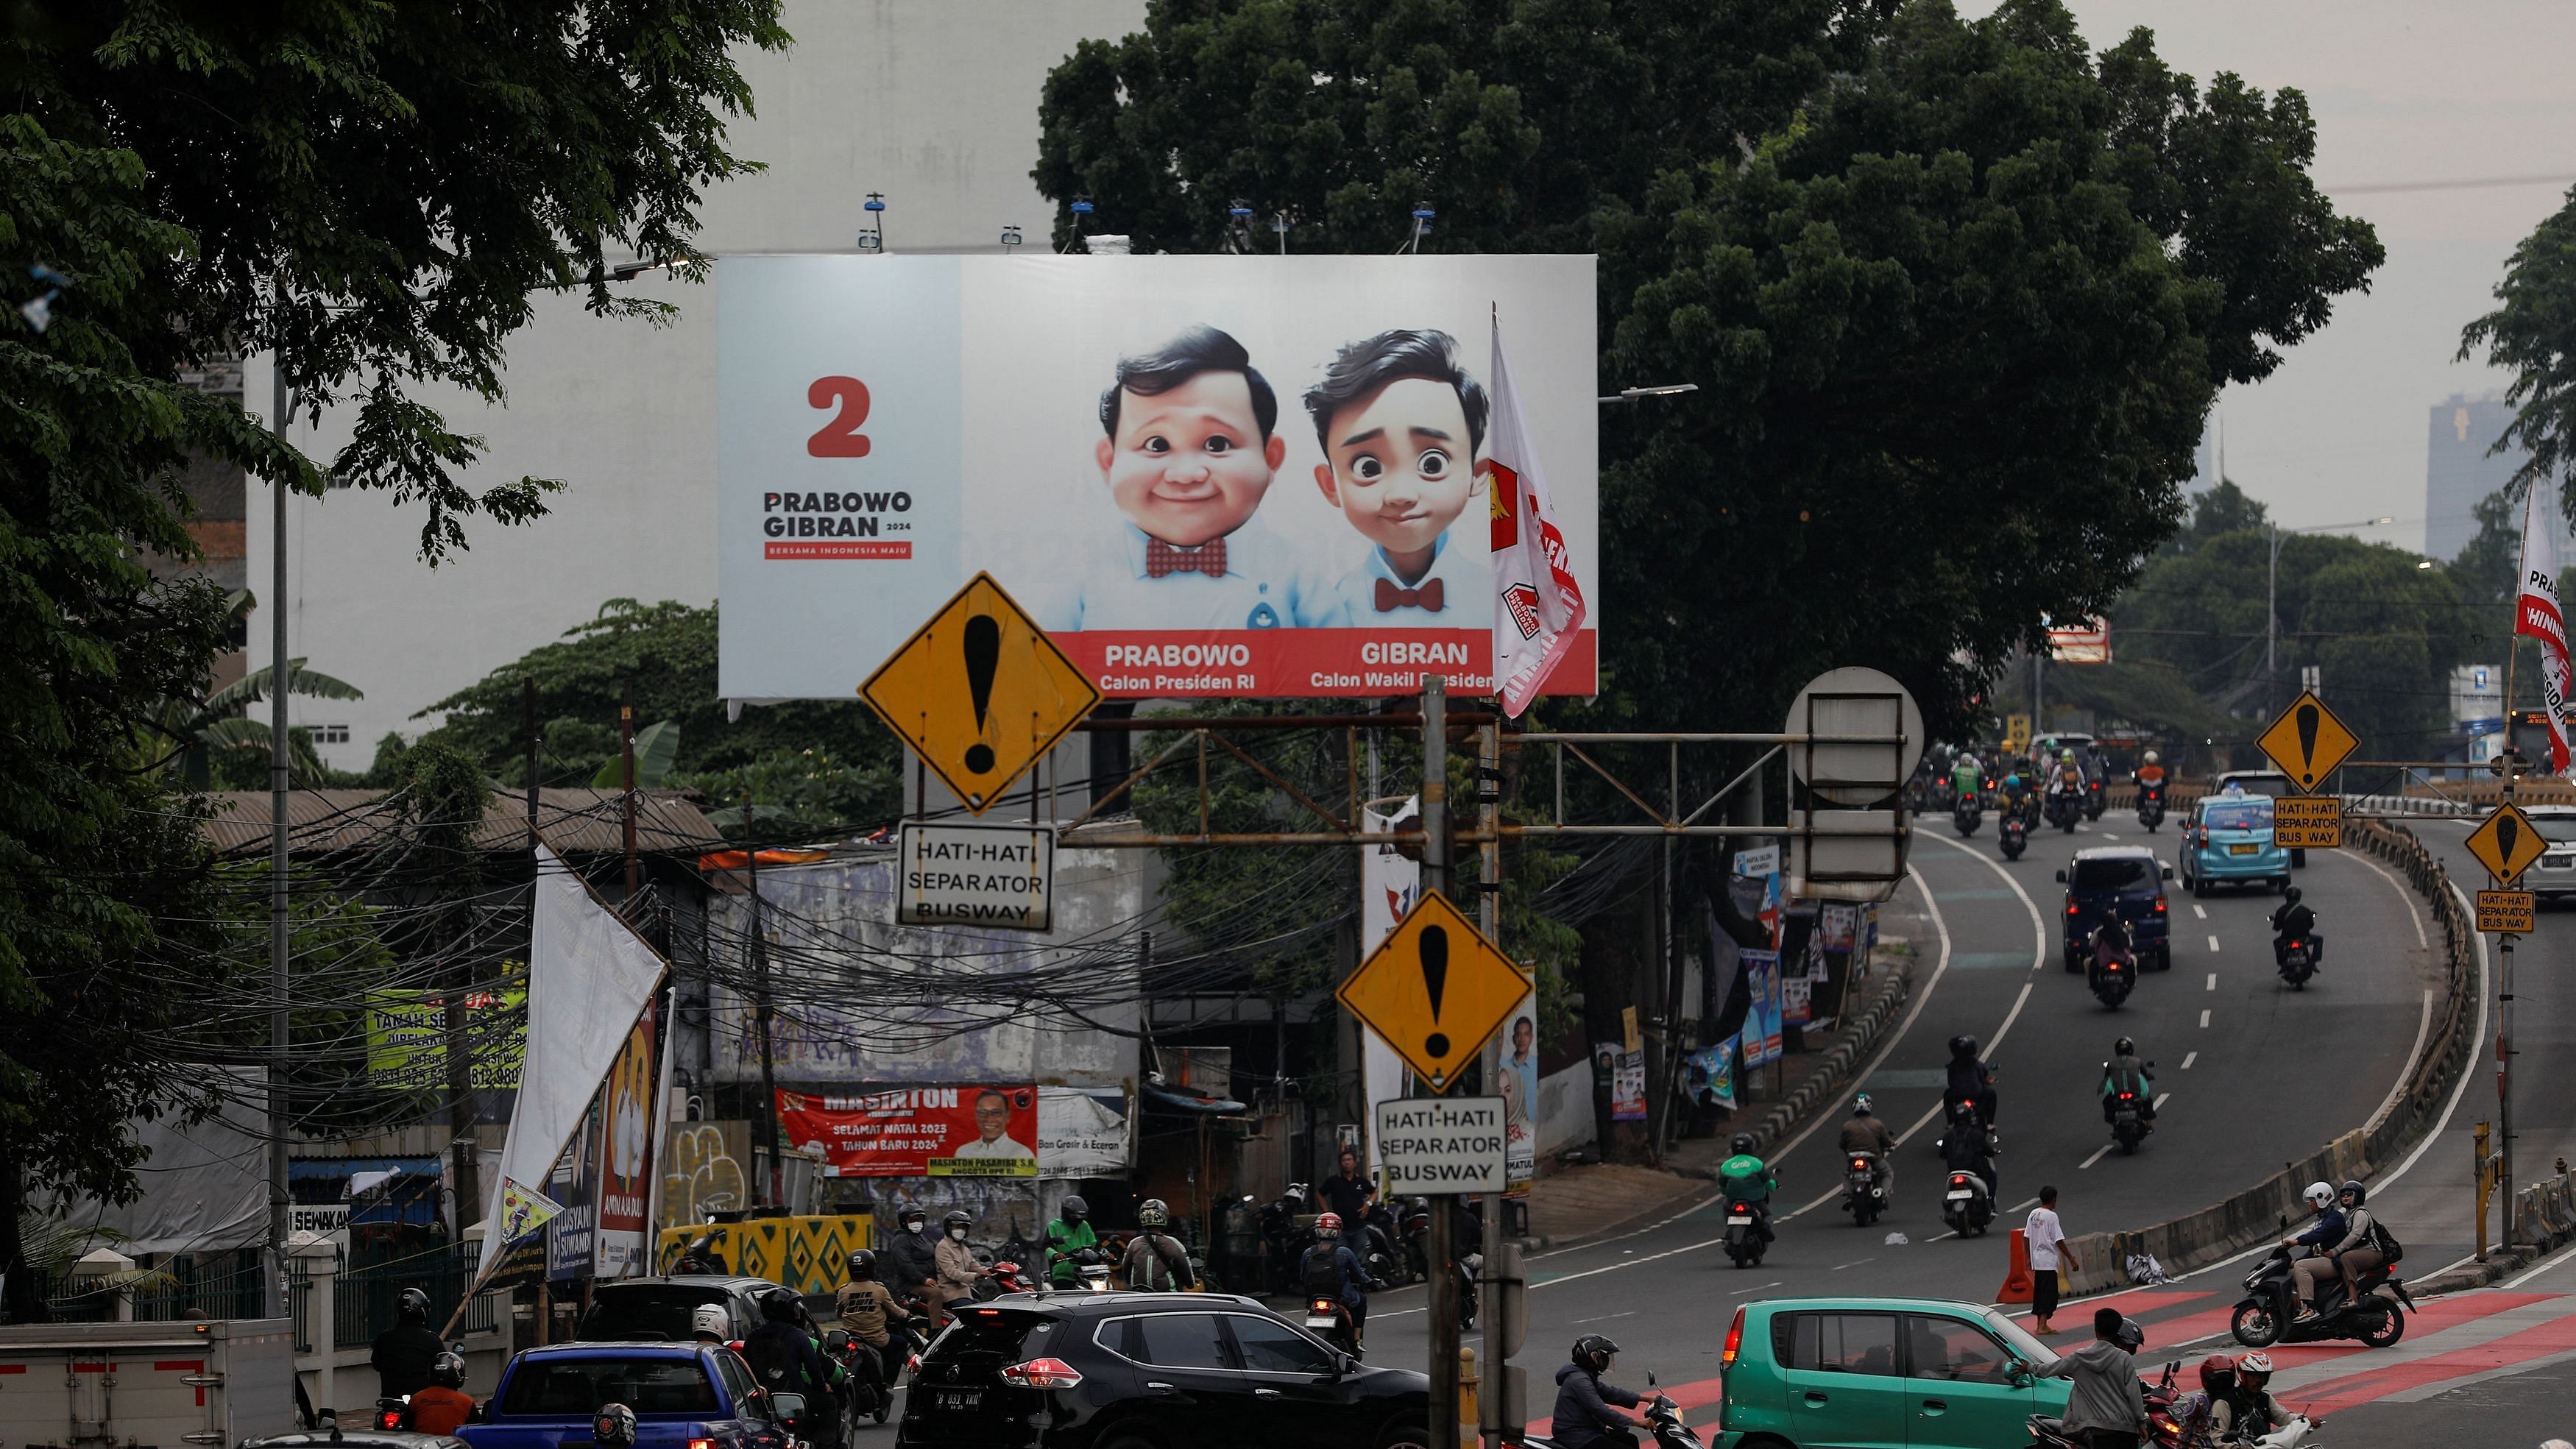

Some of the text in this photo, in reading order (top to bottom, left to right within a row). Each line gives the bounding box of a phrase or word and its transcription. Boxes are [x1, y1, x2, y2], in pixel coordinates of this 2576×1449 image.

[807, 375, 871, 458] 2
[764, 492, 912, 512] PRABOWO
[764, 517, 911, 536] GIBRAN 2024
[769, 547, 907, 555] BERSAMA INDONESIA MAJU
[1507, 593, 1533, 635] PRESIDEN
[1511, 589, 1536, 631] PRABOWO
[1105, 644, 1250, 667] PRABOWO
[1361, 641, 1468, 665] GIBRAN
[1100, 674, 1255, 691] Calon Presiden RI
[1311, 671, 1360, 688] Calon
[1364, 671, 1416, 687] Wakil
[2278, 804, 2337, 814] HATI-HATI
[2276, 818, 2338, 829] SEPARATOR
[2279, 832, 2334, 843] BUS WAY
[918, 842, 1036, 862] HATI-HATI
[908, 872, 1042, 894] SEPARATOR
[2482, 895, 2529, 905] HATI-HATI
[916, 903, 1030, 921] BUSWAY
[2479, 907, 2532, 917] SEPARATOR
[2483, 919, 2526, 928] BUS WAY
[1386, 1110, 1494, 1130] HATI-HATI
[832, 1124, 947, 1136] SELAMAT NATAL 2023
[841, 1140, 938, 1152] TAHUN BARU 2024
[1038, 1139, 1119, 1149] Ban Grosir & Eceran
[1381, 1137, 1501, 1156] SEPARATOR
[930, 1158, 974, 1167] MASINTON
[1731, 1160, 1751, 1169] Grab
[1389, 1164, 1493, 1181] BUSWAY
[295, 1211, 351, 1231] SEWAKAN
[561, 1204, 592, 1233] LUSYANI
[561, 1231, 592, 1258] SUWANDI
[938, 1393, 979, 1405] B 831 TKR
